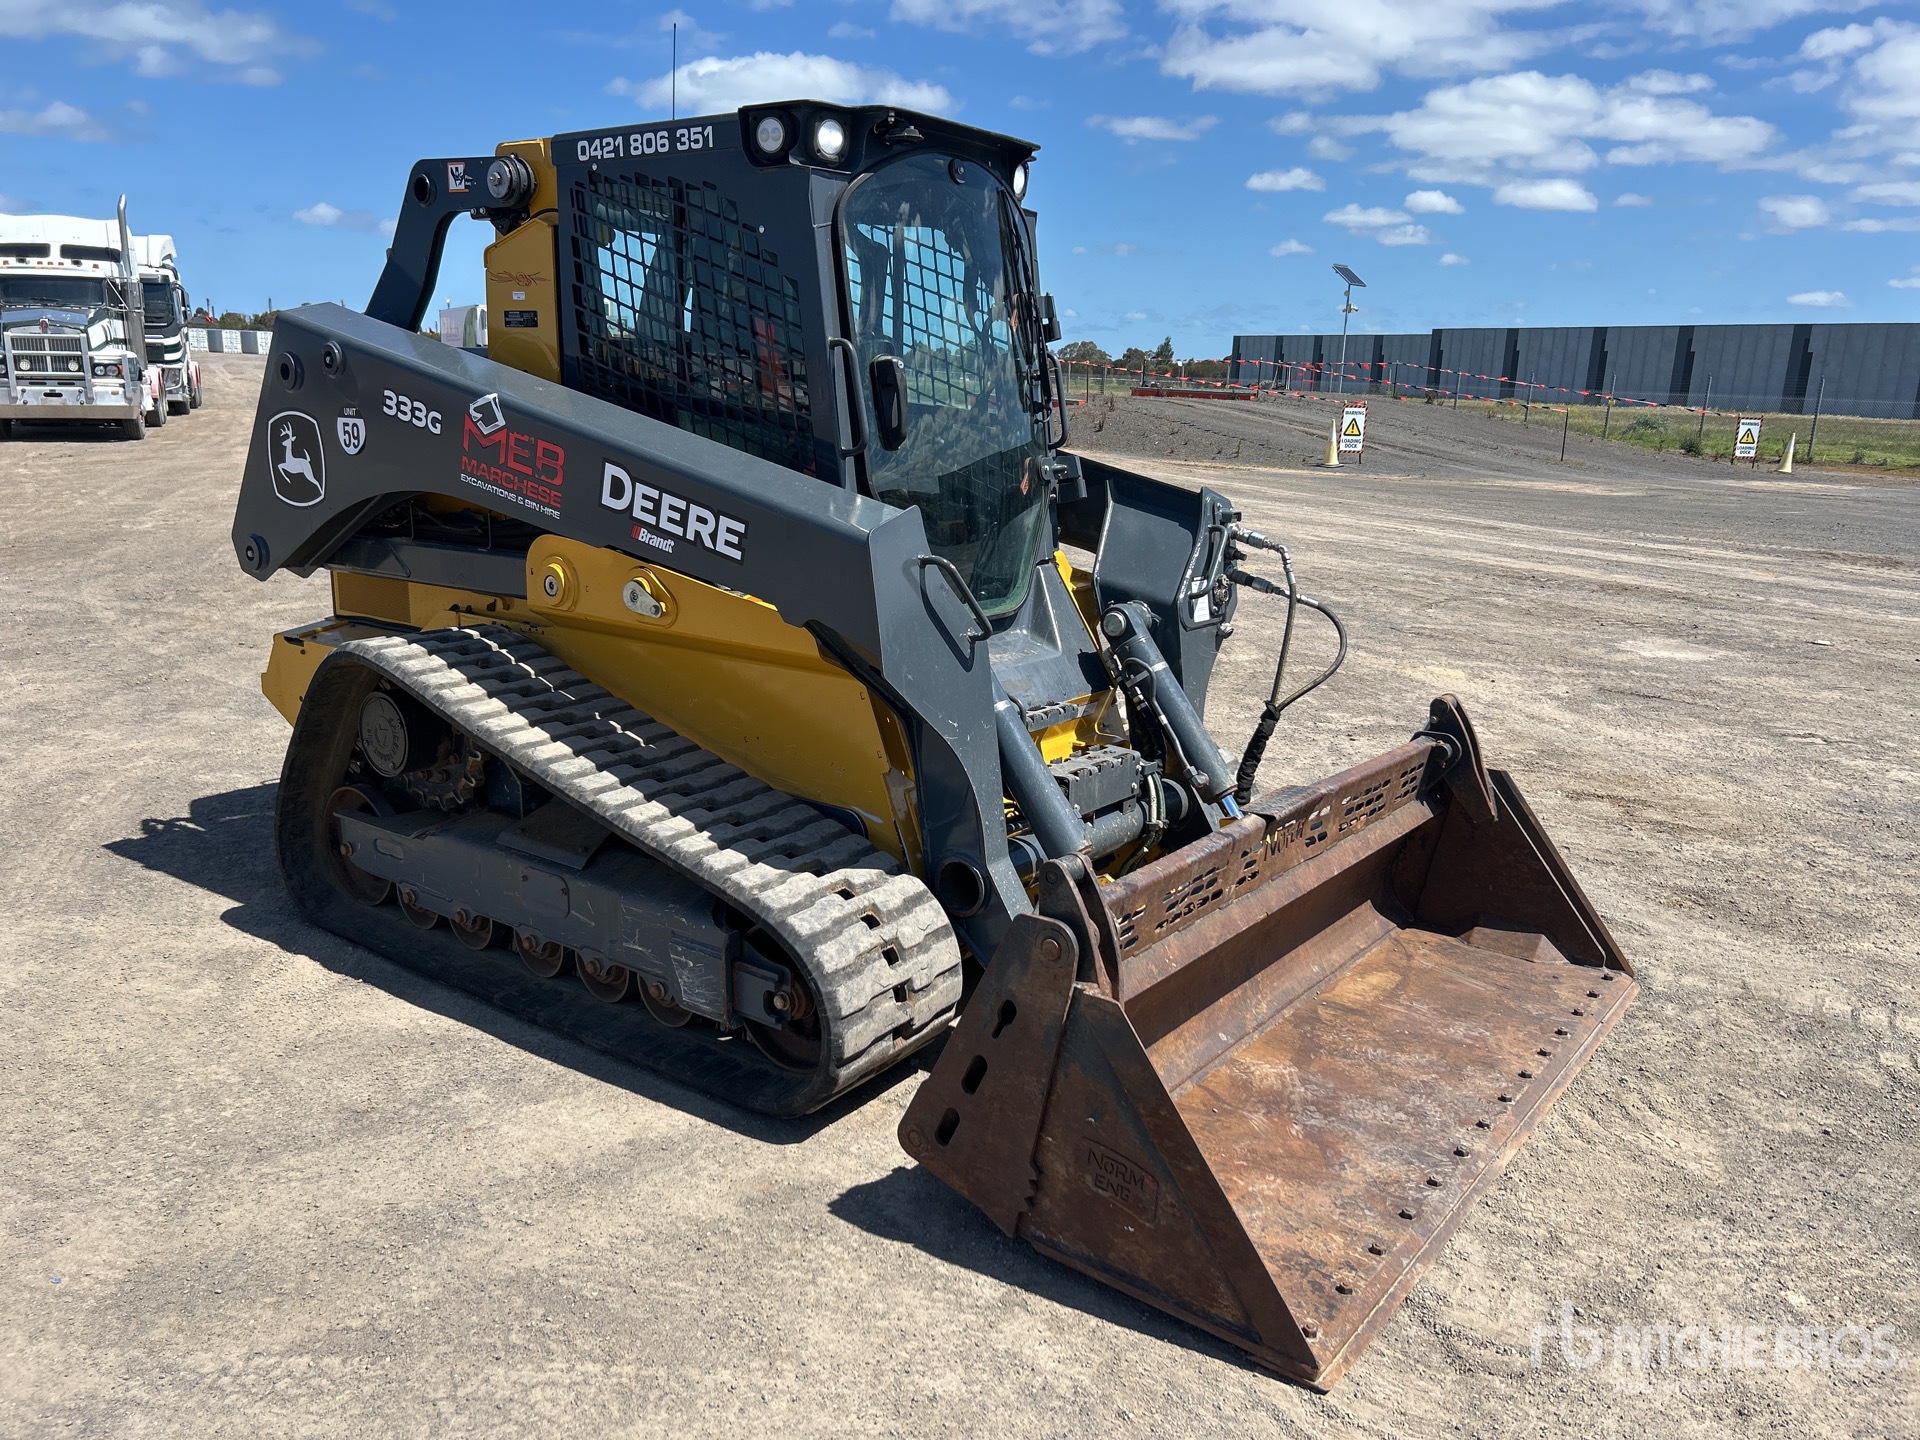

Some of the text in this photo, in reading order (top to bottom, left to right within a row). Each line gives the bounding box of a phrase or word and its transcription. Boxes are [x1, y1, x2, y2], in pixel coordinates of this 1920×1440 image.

[577, 125, 714, 162] 0421 806 351
[343, 407, 357, 416] UNIT
[382, 389, 443, 436] 333G
[342, 421, 361, 449] 59
[460, 455, 562, 508] MARCHESE
[460, 473, 561, 520] EXCAVATIONS & BIN HIRE
[601, 461, 746, 561] DEERE
[638, 527, 675, 554] Brandt
[1094, 1172, 1131, 1203] ENG
